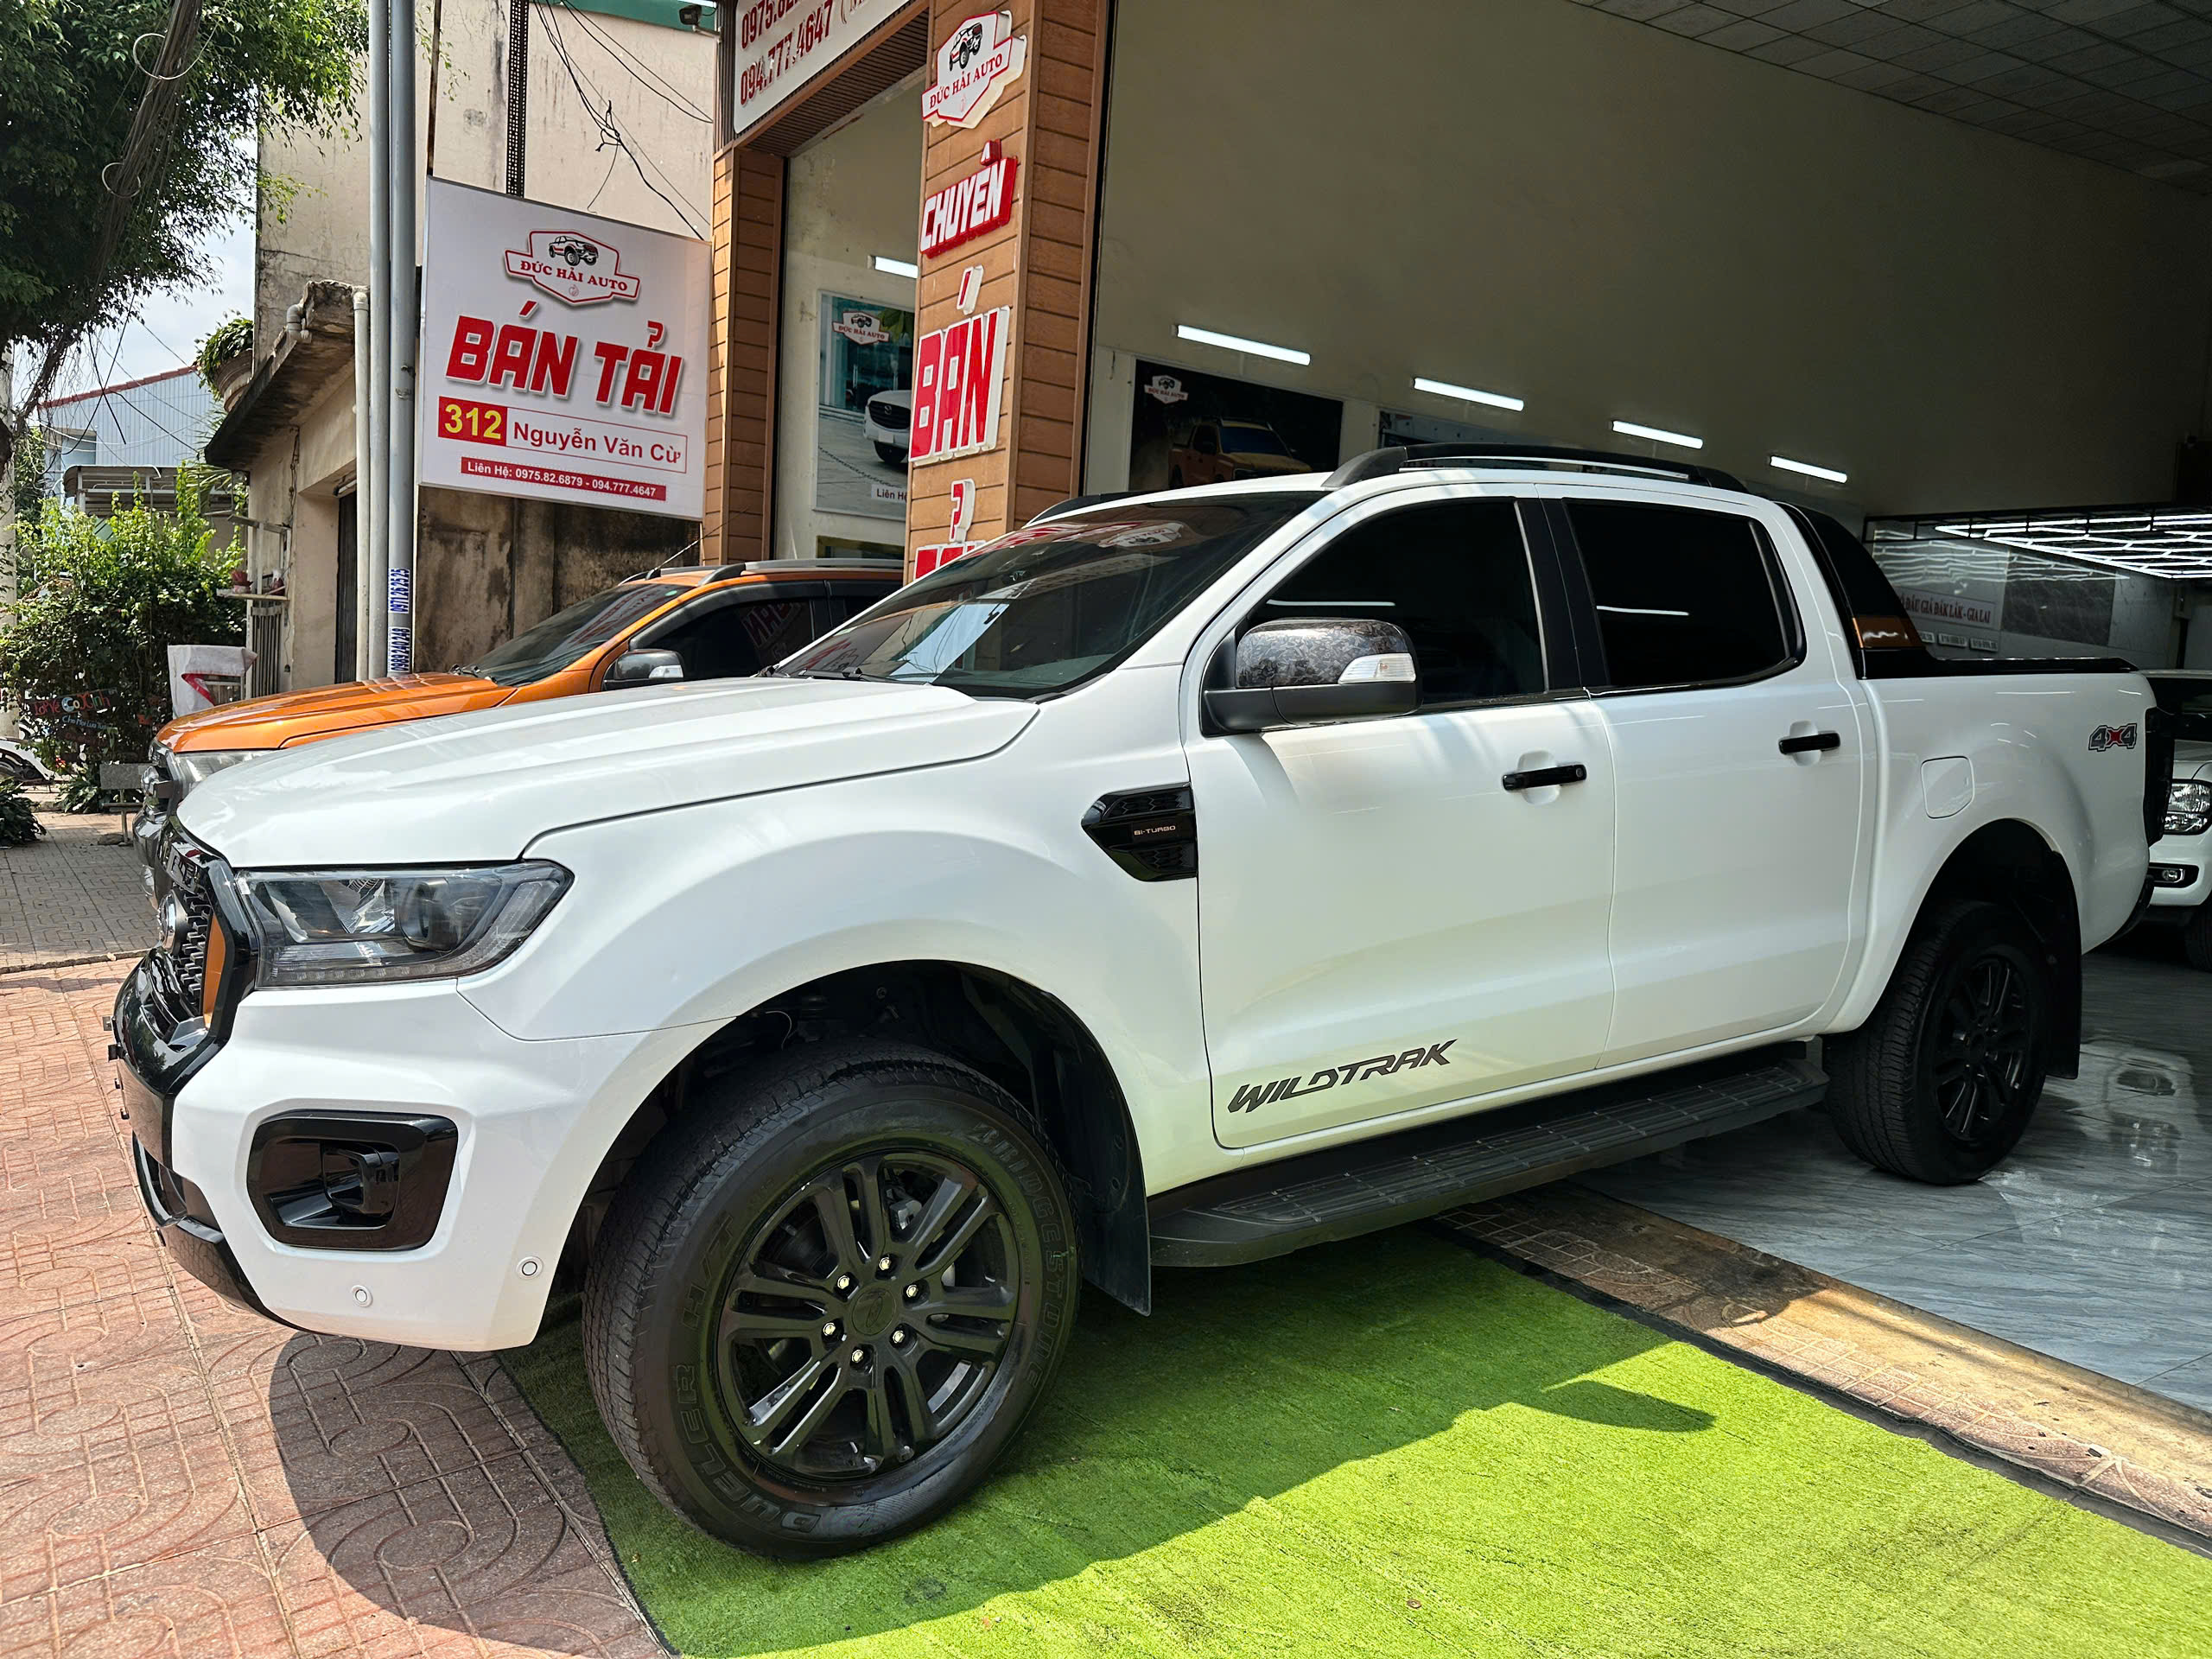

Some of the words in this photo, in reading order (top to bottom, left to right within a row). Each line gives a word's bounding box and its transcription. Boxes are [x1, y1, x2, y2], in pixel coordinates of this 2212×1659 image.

[952, 71, 970, 95] HẢI
[973, 54, 1002, 82] AUTO
[920, 139, 1013, 256] CHUYÊN
[520, 260, 552, 276] ĐỨC
[556, 267, 583, 283] HẢI
[588, 275, 627, 290] AUTO
[445, 301, 578, 397] BÁN
[594, 321, 683, 415] TẢI
[909, 267, 1004, 462] BÁN
[444, 404, 501, 440] 312
[514, 422, 596, 450] Nguyễn
[604, 435, 643, 458] Văn
[651, 443, 681, 463] Cừ
[467, 461, 491, 474] Liên
[494, 465, 512, 478] Hệ:
[515, 468, 583, 486] 0975.82.6879
[592, 480, 656, 497] 094.777.4647
[877, 488, 895, 499] Liên
[1134, 825, 1176, 836] BI-TURBO
[1227, 1039, 1458, 1113] WILDTRAK
